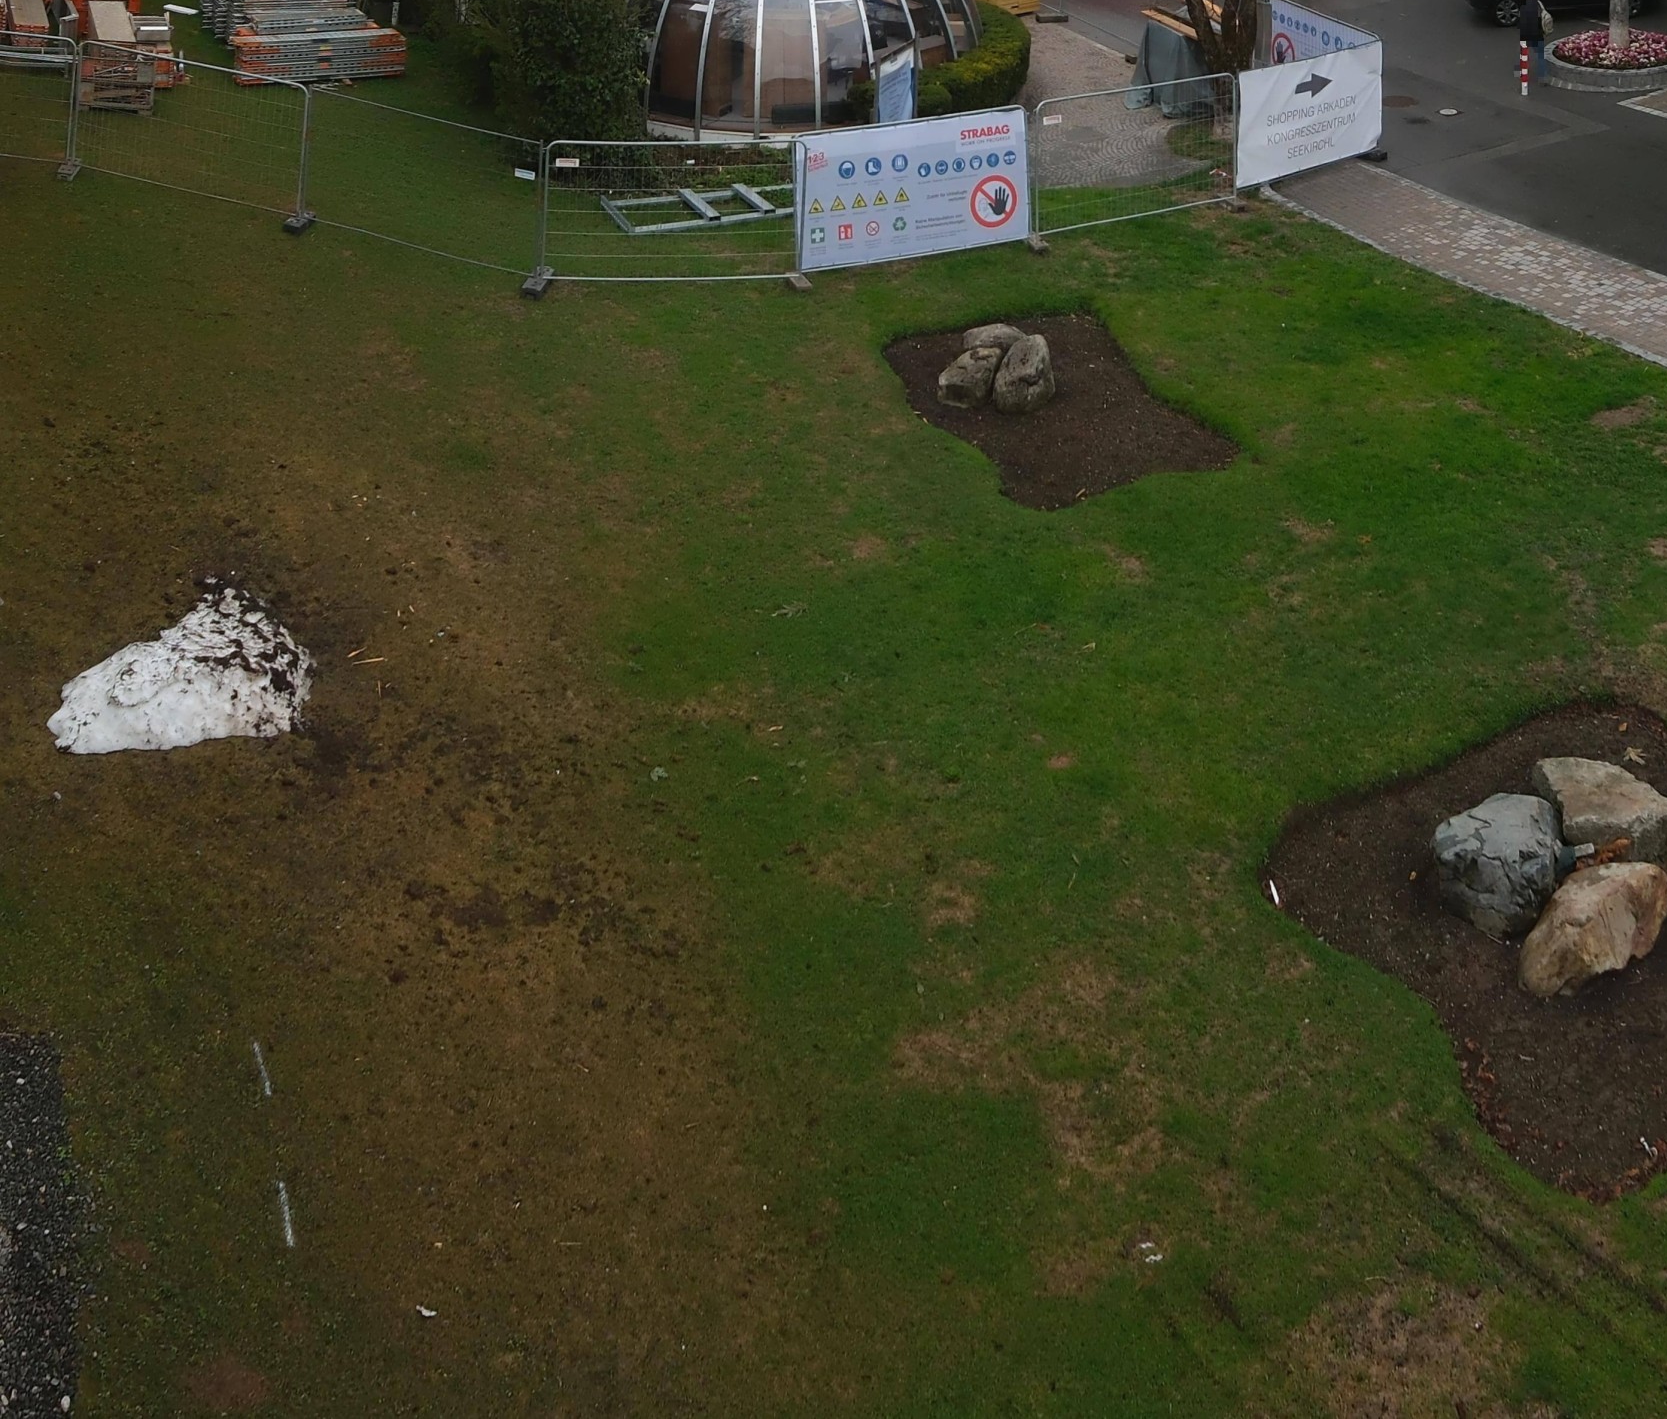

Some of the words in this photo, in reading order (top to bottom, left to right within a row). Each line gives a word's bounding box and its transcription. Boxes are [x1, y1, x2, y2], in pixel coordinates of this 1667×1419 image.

[1267, 106, 1315, 127] SHOPPING
[1317, 95, 1357, 115] ARKADEN
[960, 124, 1010, 140] STRABAG
[1267, 112, 1356, 146] KONGRESSZENTRUM
[1287, 137, 1335, 159] SEEKIRCHL
